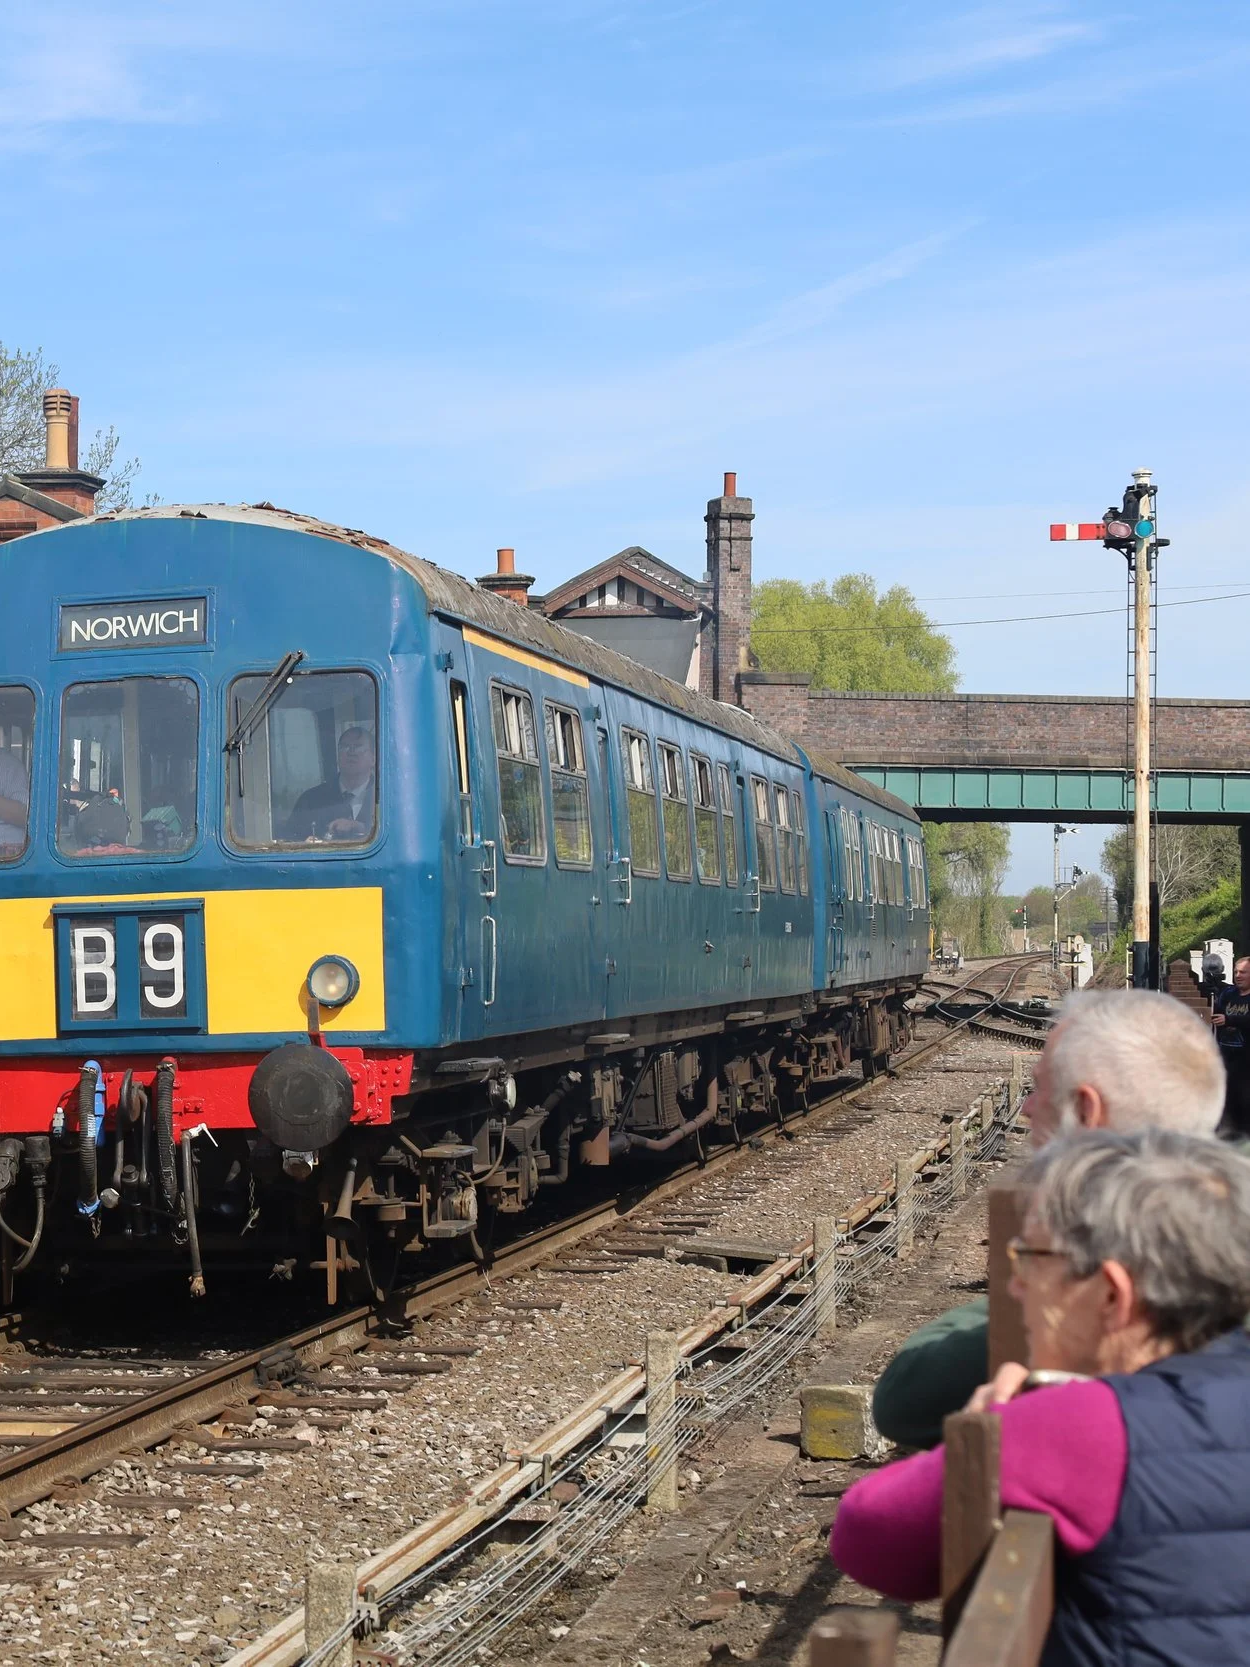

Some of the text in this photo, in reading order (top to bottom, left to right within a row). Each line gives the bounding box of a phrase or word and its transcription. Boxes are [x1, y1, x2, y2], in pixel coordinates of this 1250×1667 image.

[71, 608, 198, 643] NORWICH
[74, 923, 184, 1012] B 9
